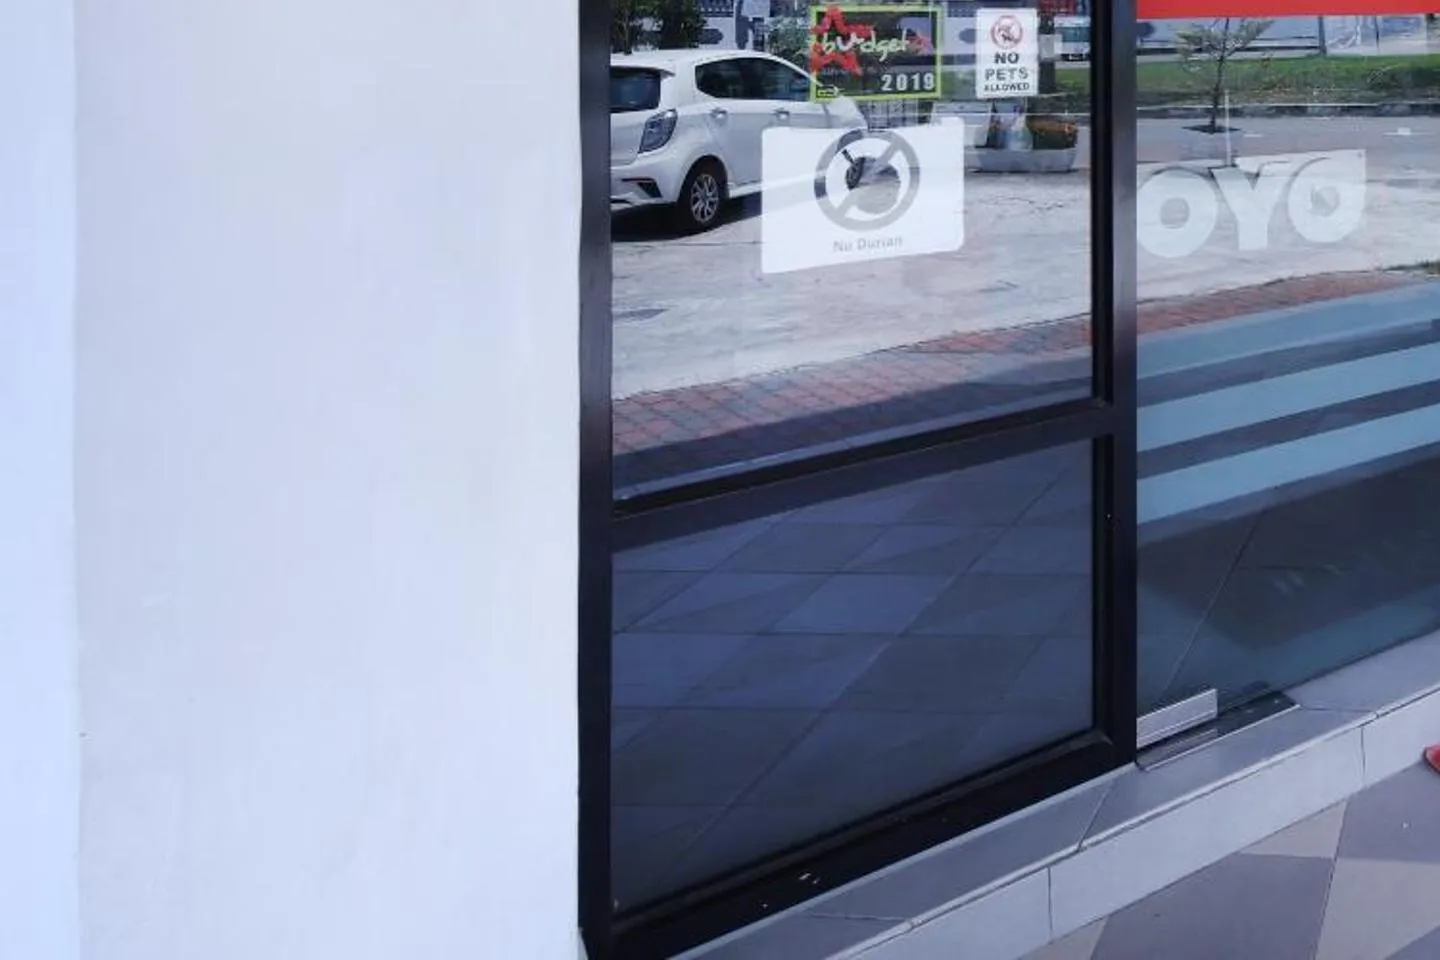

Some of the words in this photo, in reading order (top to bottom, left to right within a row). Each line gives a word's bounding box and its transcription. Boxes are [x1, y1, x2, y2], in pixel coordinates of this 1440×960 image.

[994, 52, 1020, 65] NO
[985, 67, 1029, 81] PETS
[881, 73, 935, 92] 2019
[984, 82, 1030, 92] ALLOWED
[1137, 157, 1364, 258] OYO
[833, 239, 853, 253] No
[857, 236, 903, 250] Durian
